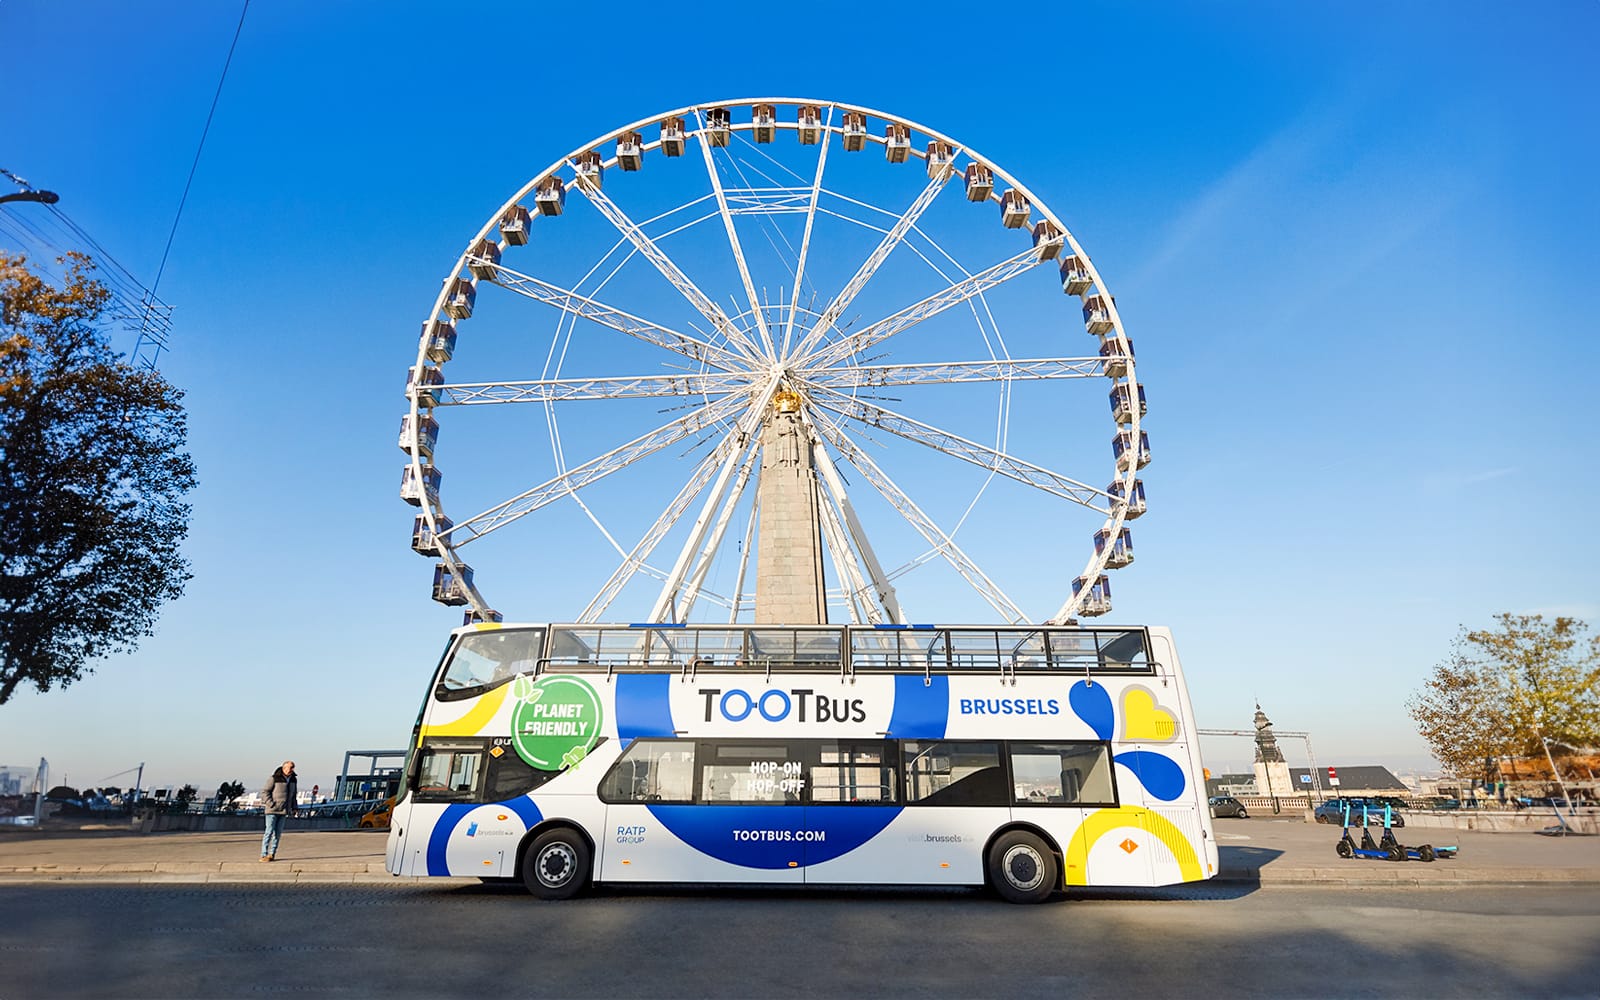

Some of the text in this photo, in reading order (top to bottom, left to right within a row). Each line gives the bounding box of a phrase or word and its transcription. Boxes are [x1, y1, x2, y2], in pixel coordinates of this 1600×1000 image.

[533, 703, 584, 718] PLANET
[960, 699, 1060, 715] BRUSSELS
[524, 721, 588, 736] FRIENDLY
[750, 761, 802, 775] HOP-ON
[747, 780, 806, 793] HOP-OFF
[617, 826, 647, 836] RATP
[732, 830, 826, 841] TOOTBUS.COM
[616, 836, 645, 844] GROUP
